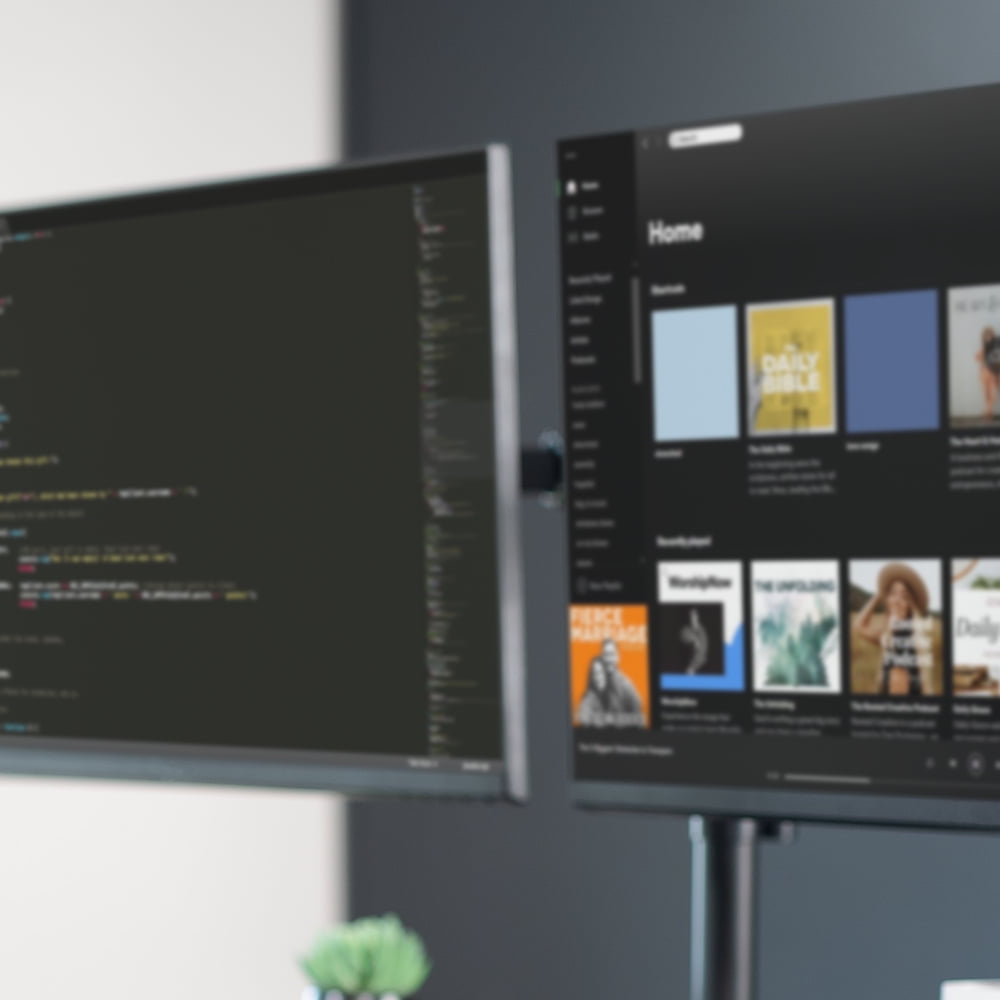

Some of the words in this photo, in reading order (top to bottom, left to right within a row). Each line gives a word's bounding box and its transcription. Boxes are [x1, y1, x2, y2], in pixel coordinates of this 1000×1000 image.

[648, 220, 703, 245] Home
[761, 352, 819, 373] DAILY
[761, 372, 821, 394] BIBLE
[667, 576, 733, 591] WorshipNow
[755, 580, 773, 592] THE
[776, 580, 835, 593] UNFOLDING
[570, 606, 623, 625] FIERCE
[570, 624, 648, 643] MARRIAGE
